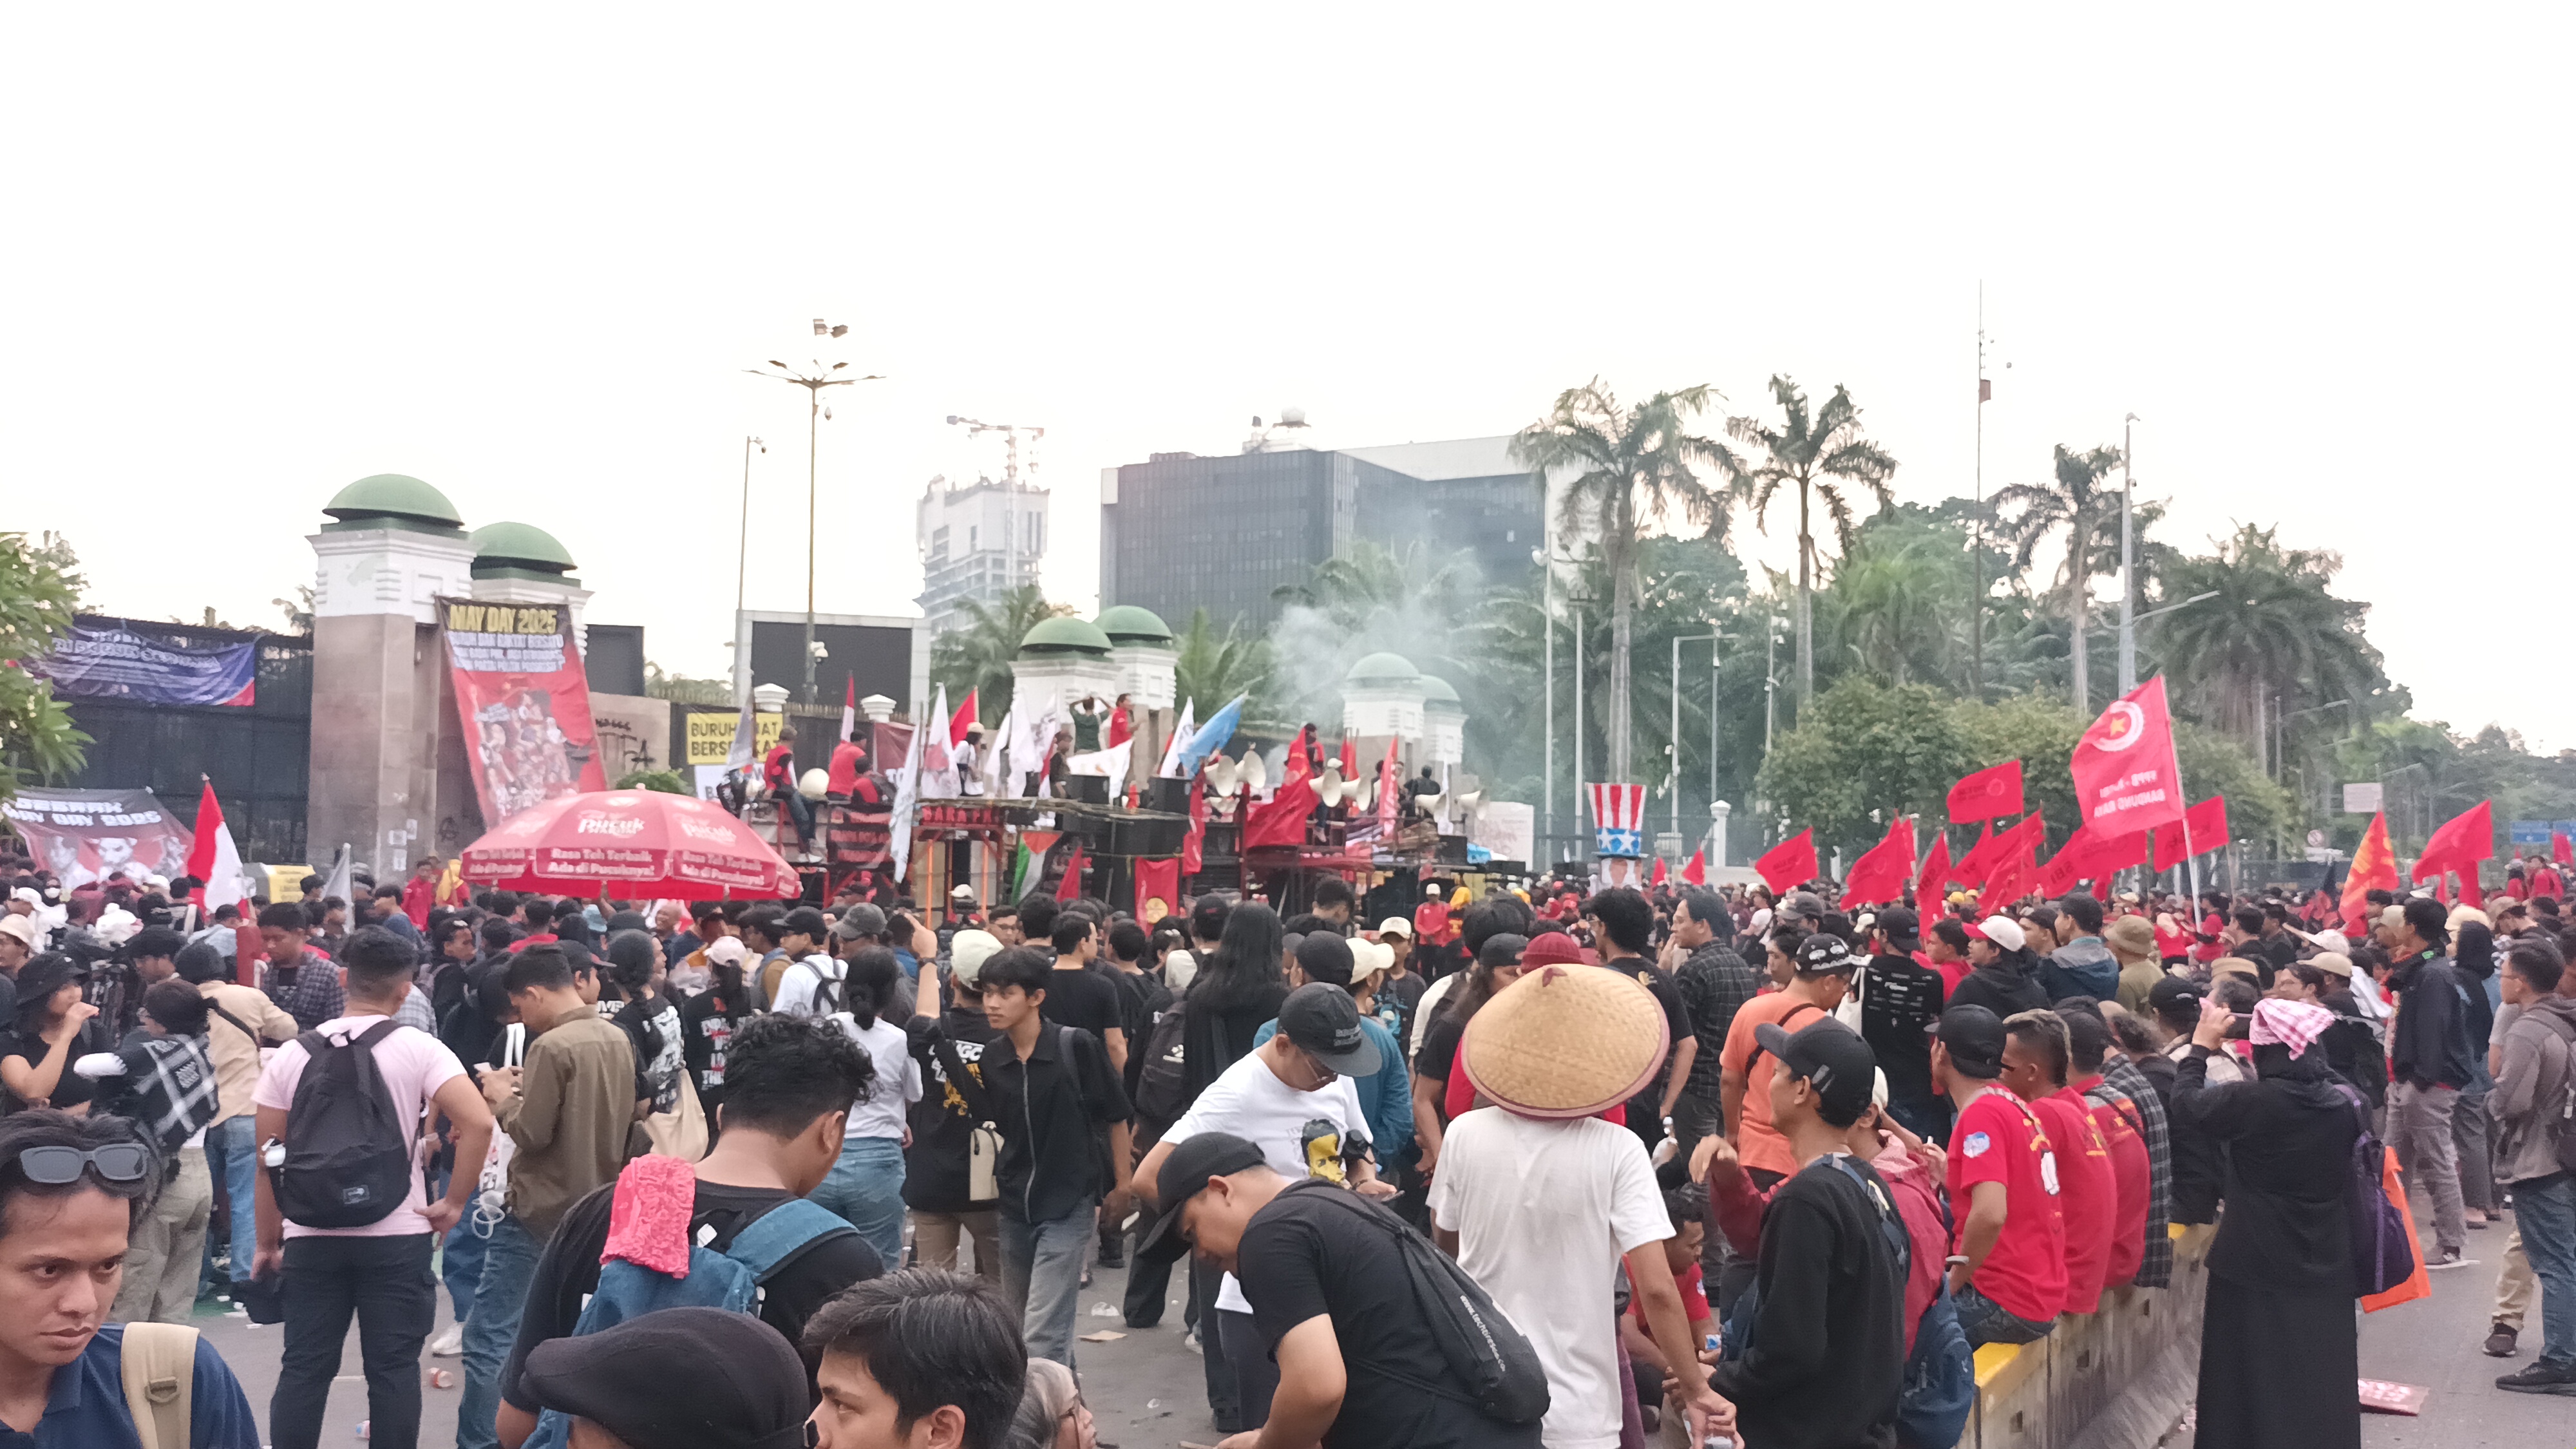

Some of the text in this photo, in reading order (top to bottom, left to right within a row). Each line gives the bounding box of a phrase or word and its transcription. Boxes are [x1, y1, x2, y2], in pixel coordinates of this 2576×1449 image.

[450, 605, 558, 634] MAY DAY 2025
[691, 723, 737, 737] BURUH
